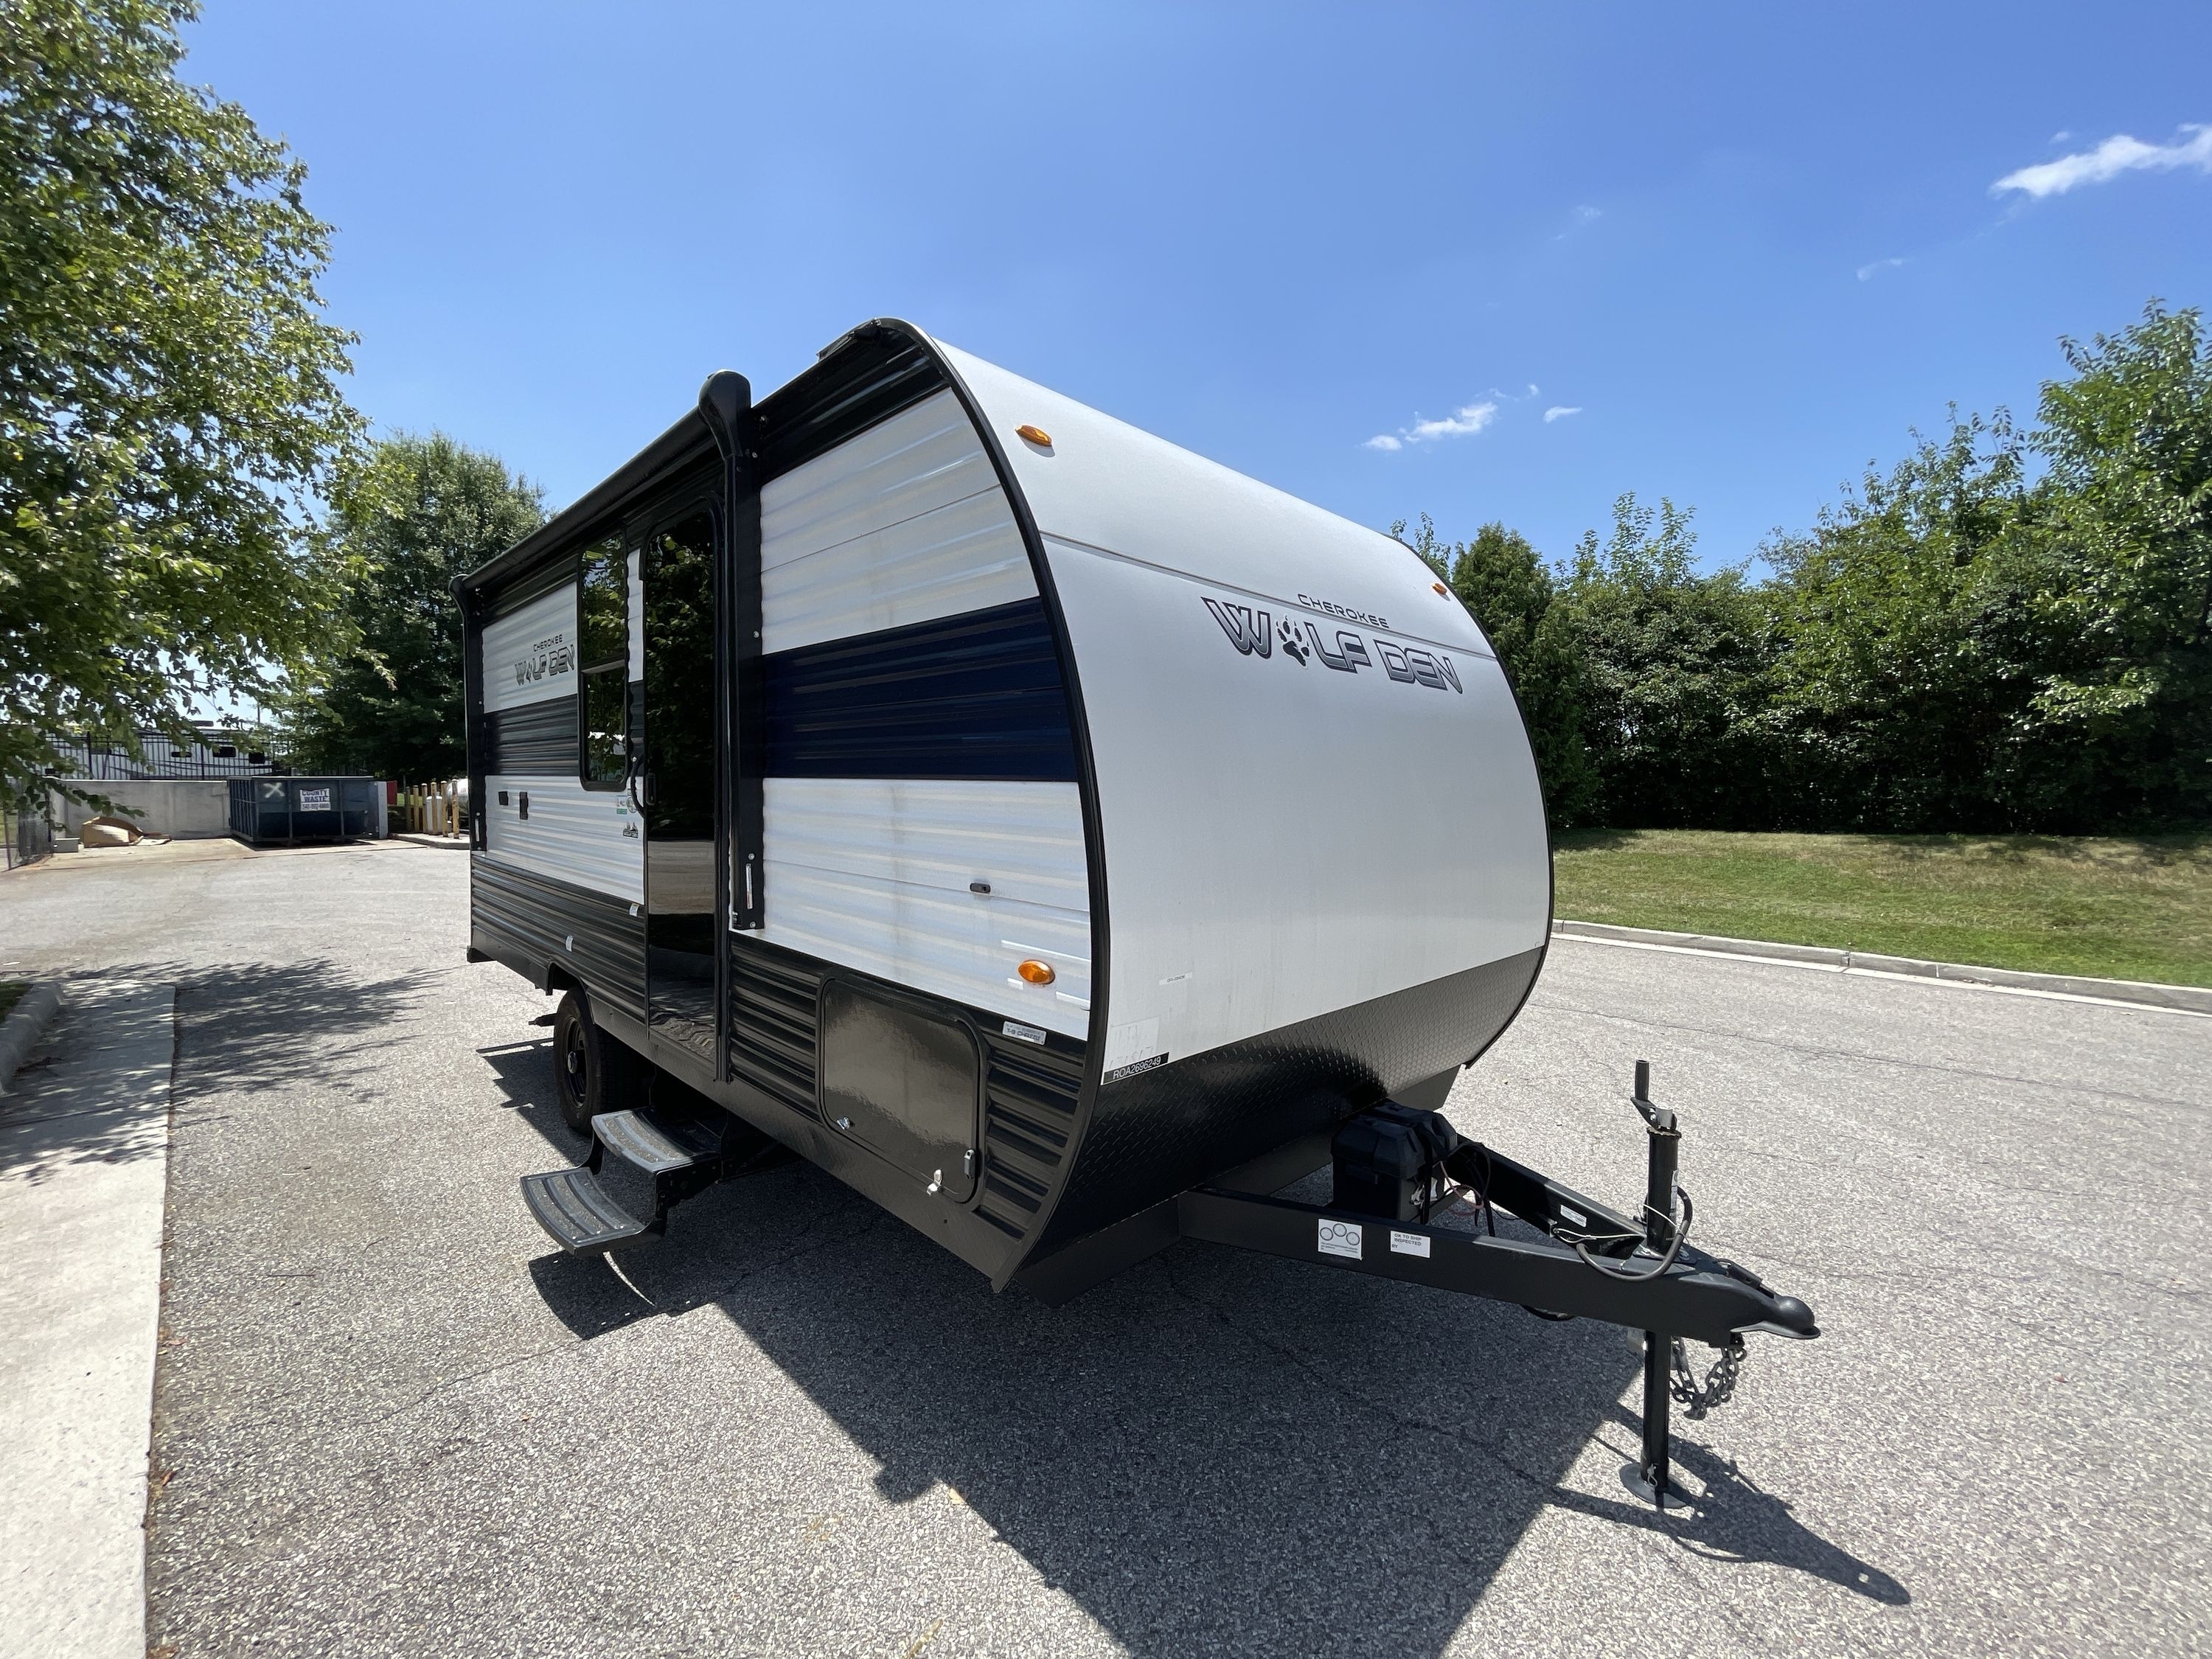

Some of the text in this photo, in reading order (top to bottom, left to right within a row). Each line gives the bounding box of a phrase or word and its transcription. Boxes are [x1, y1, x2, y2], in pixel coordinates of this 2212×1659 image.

[1297, 594, 1389, 628] CHEROKEE
[533, 634, 563, 652] CHEROKEE
[549, 644, 574, 676] DEN
[1373, 639, 1463, 695] DEN
[1113, 1056, 1161, 1079] ROA2696249
[1394, 1238, 1422, 1246] INSPECTED
